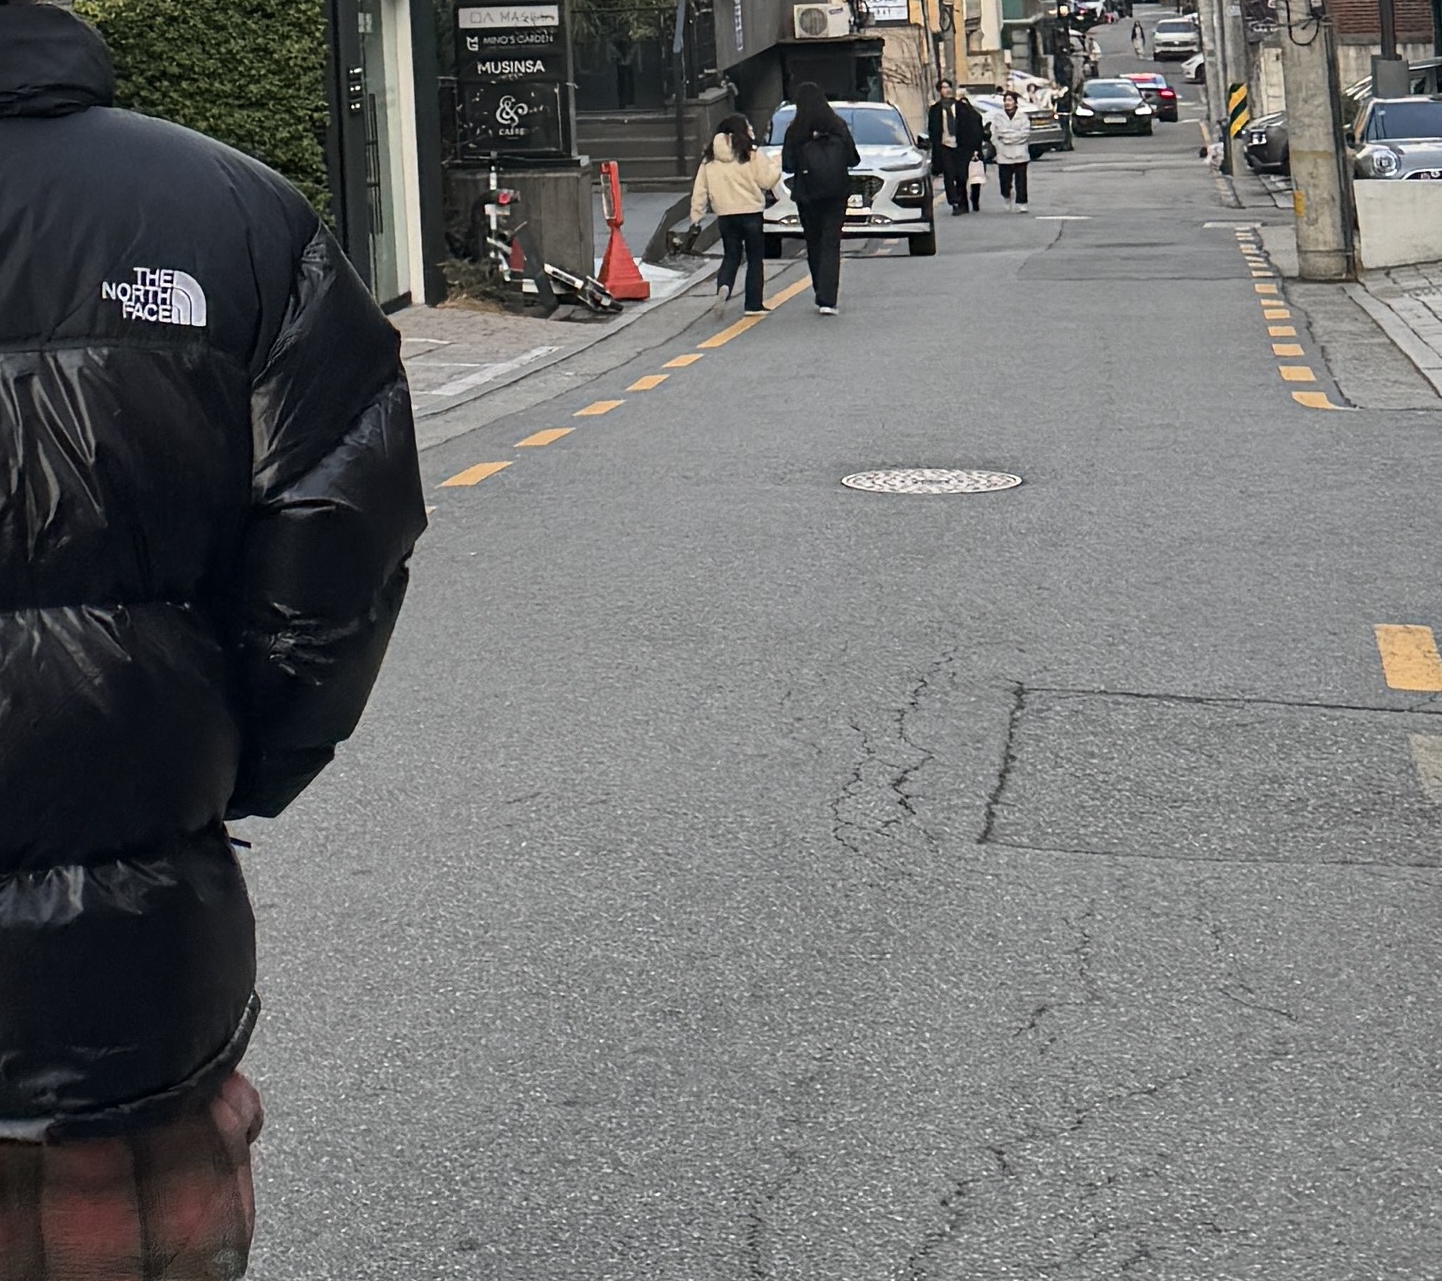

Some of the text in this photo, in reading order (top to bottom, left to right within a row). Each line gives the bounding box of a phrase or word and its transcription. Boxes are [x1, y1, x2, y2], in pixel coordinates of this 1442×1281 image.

[477, 59, 546, 75] MUSINSA
[132, 266, 174, 288] THE
[101, 280, 172, 306] NORTH
[122, 301, 172, 324] FACE
